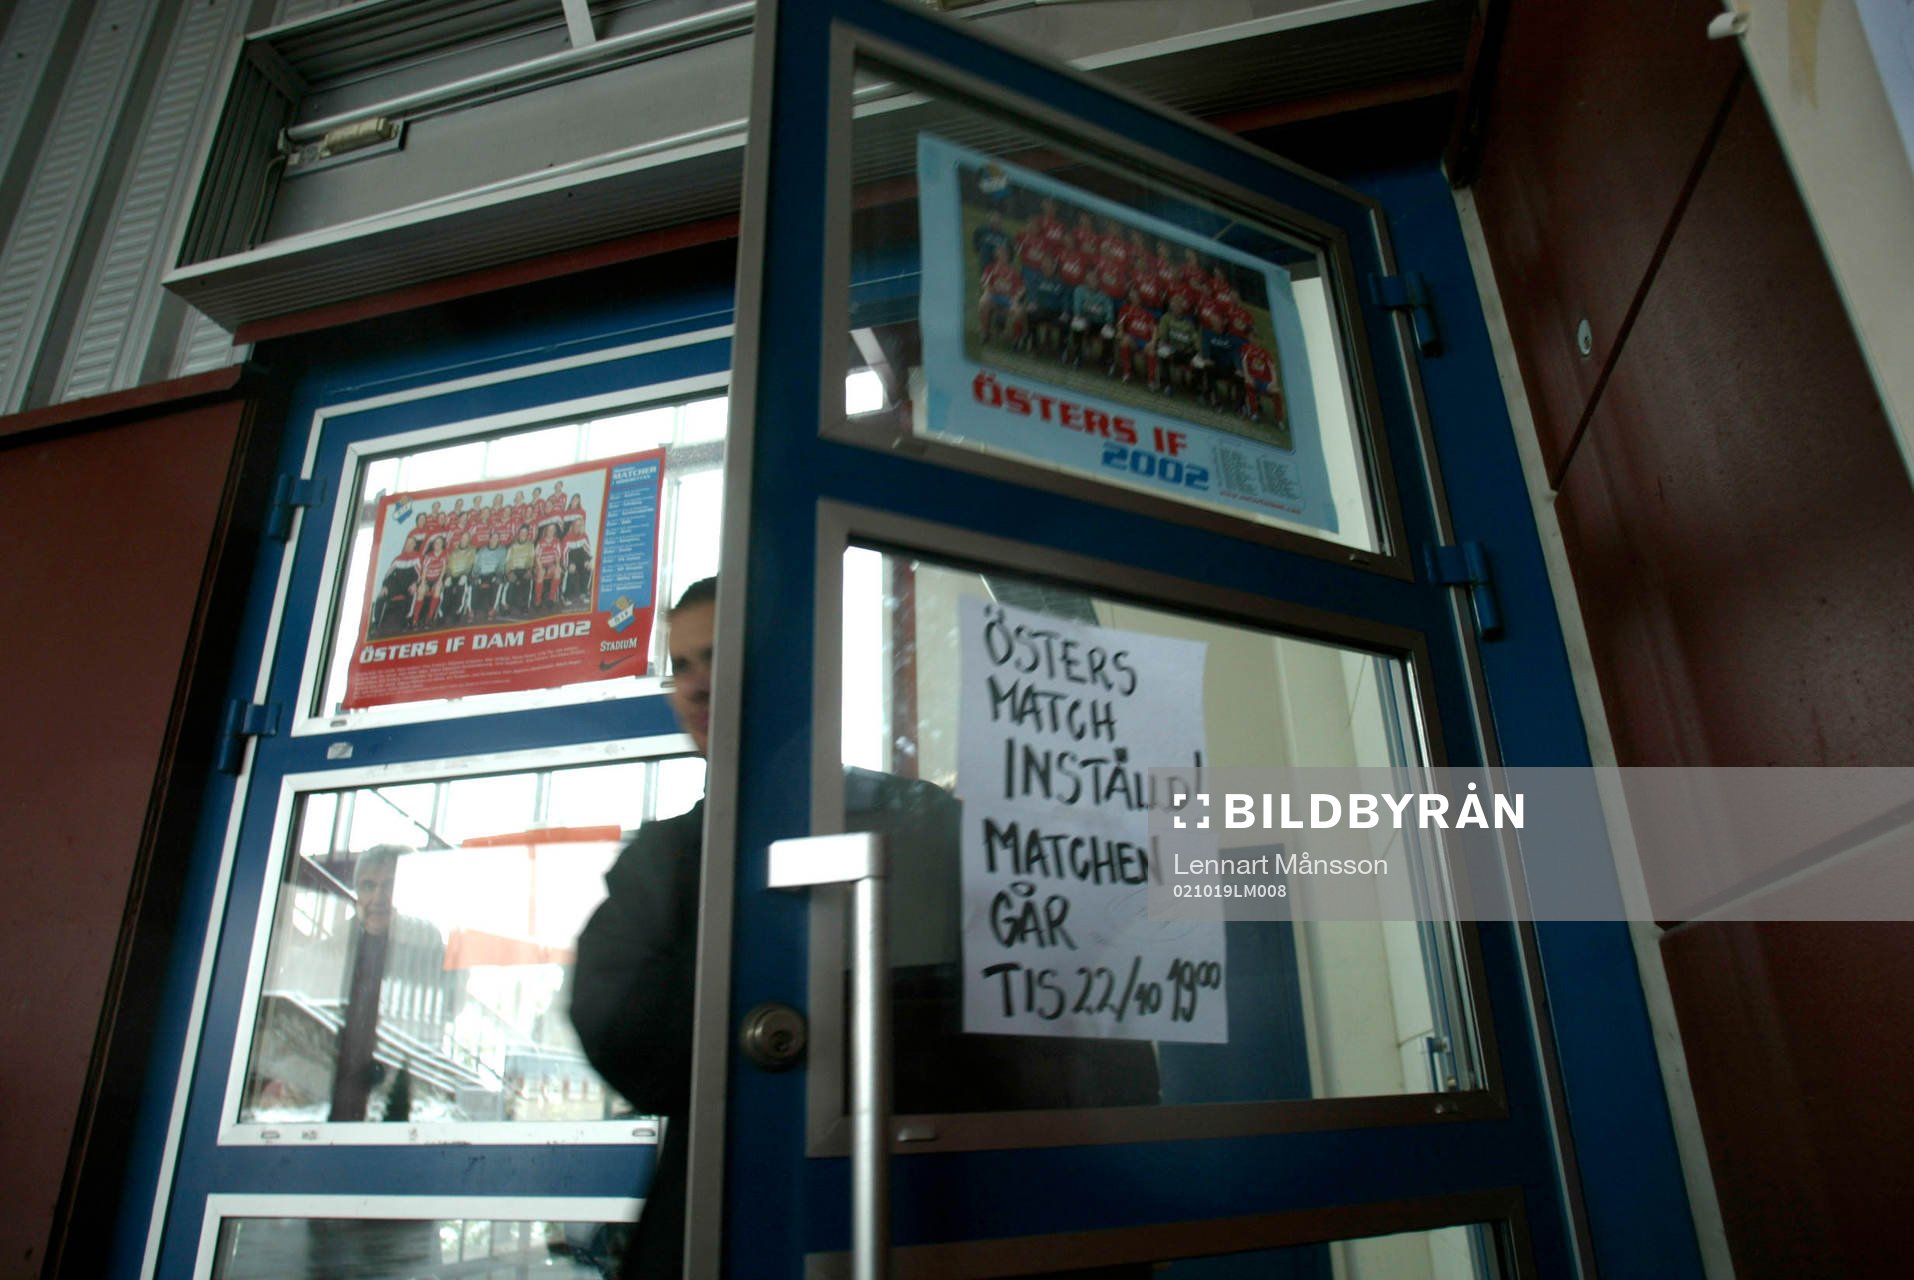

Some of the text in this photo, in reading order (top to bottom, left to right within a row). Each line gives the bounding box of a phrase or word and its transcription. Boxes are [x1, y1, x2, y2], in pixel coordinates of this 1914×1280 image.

[972, 369, 1188, 457] ÖSTERS IF
[1102, 440, 1210, 492] 2002
[359, 620, 592, 664] ÖSTERS IF DAM 2002
[984, 604, 1138, 696] ÖSTERS
[986, 675, 1117, 742] MATCH
[982, 817, 1164, 886] MATCHEN
[989, 881, 1078, 950] GÅR
[981, 962, 1066, 1020] TIS
